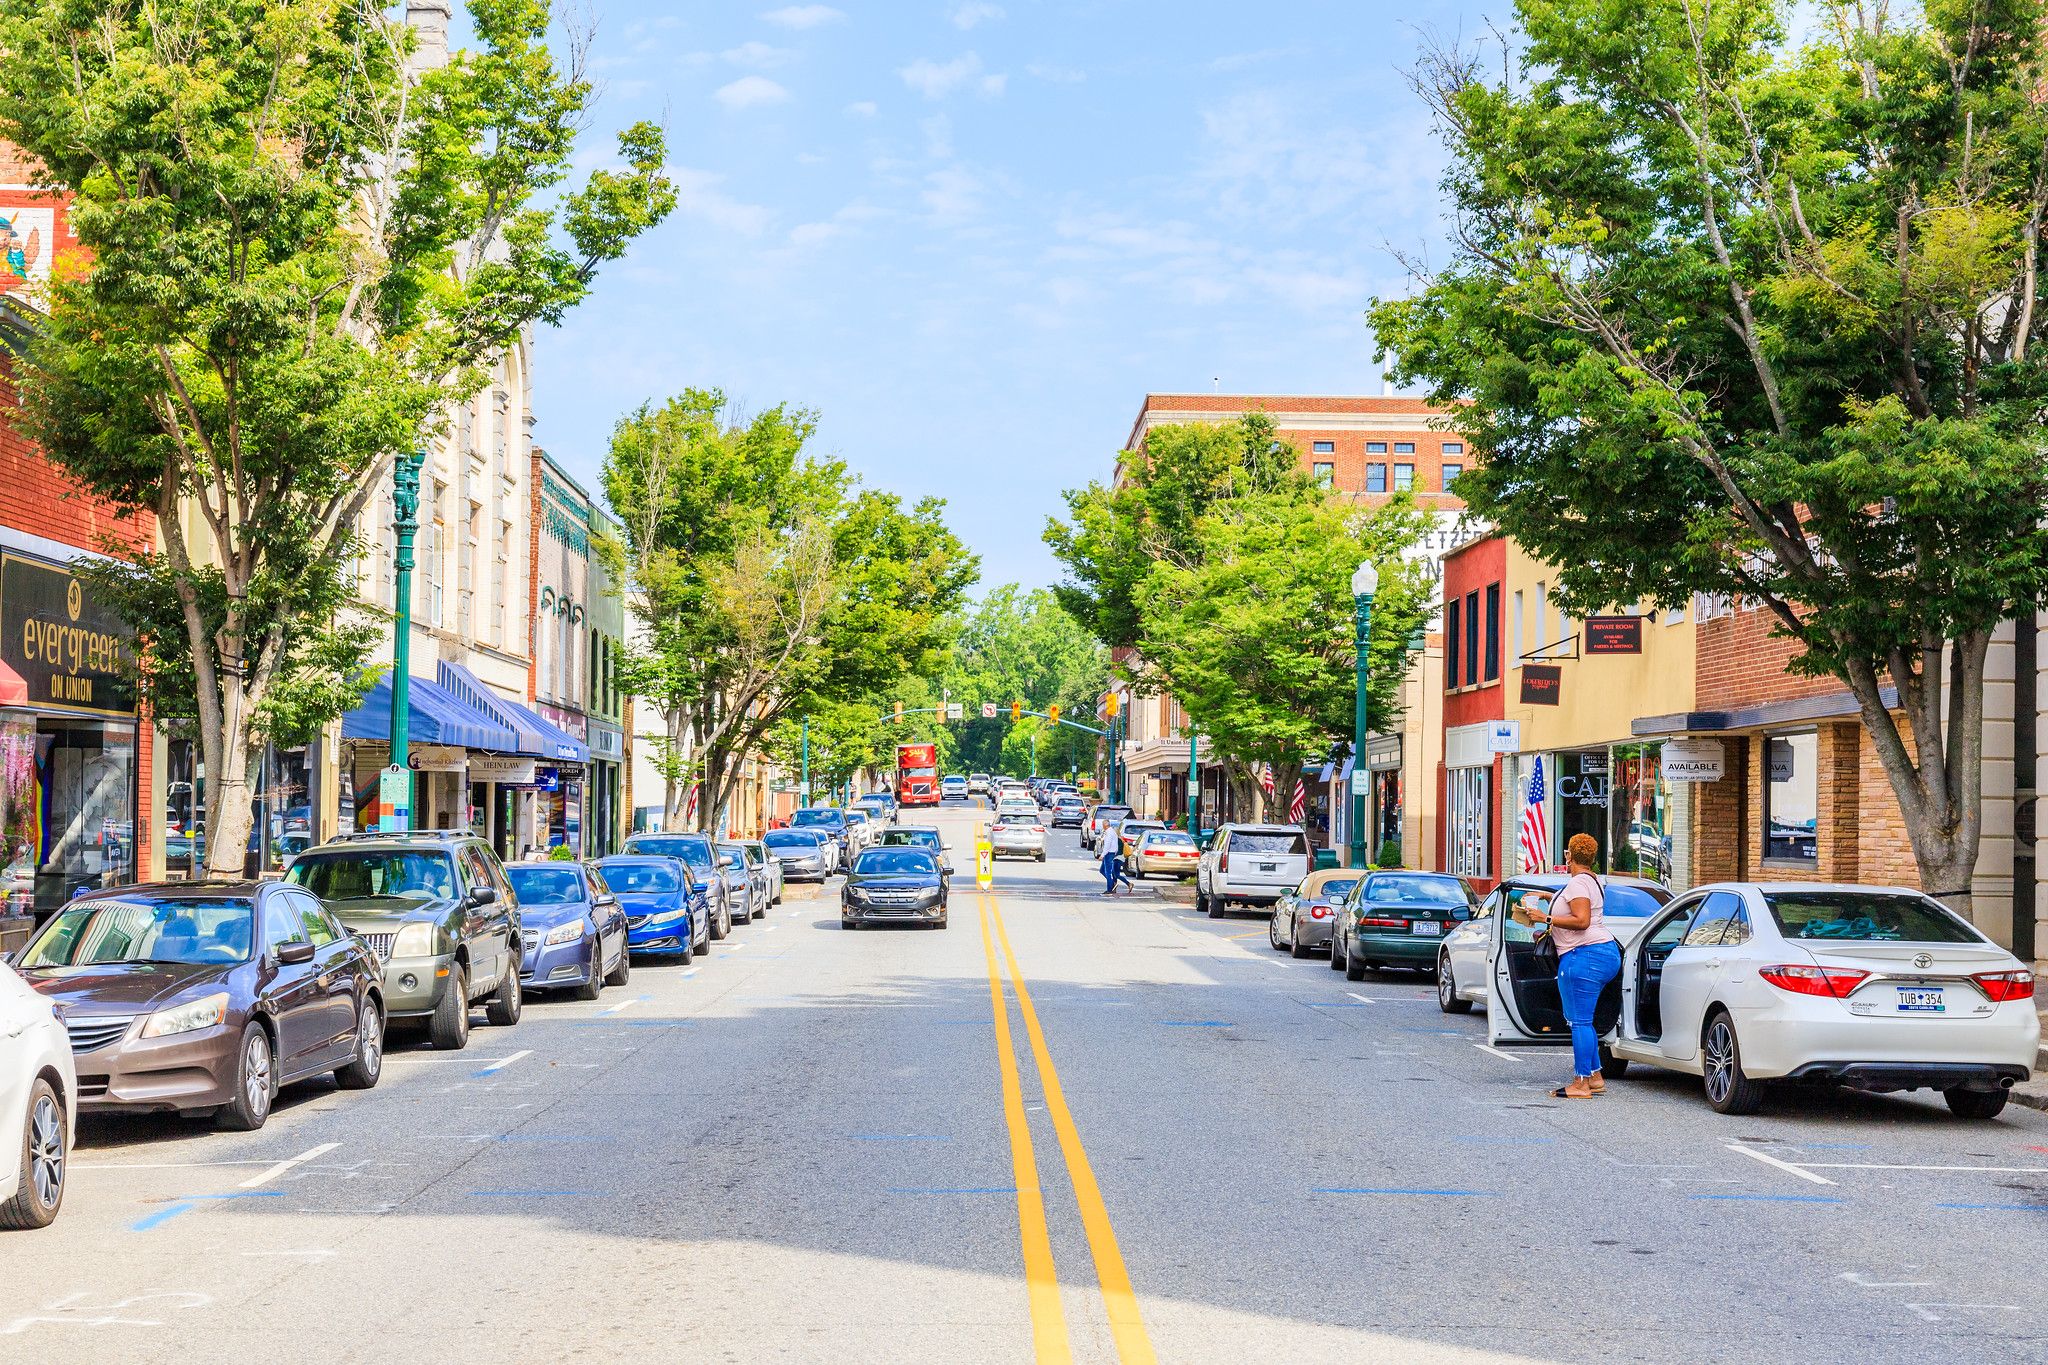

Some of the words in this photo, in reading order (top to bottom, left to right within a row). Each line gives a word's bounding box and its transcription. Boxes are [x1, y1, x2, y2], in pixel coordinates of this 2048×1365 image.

[23, 618, 119, 674] evergreen
[51, 674, 63, 698] ON
[66, 676, 93, 702] UNION
[483, 761, 502, 769] HEIN
[1899, 992, 1917, 1004] TUB
[1924, 993, 1942, 1005] 354
